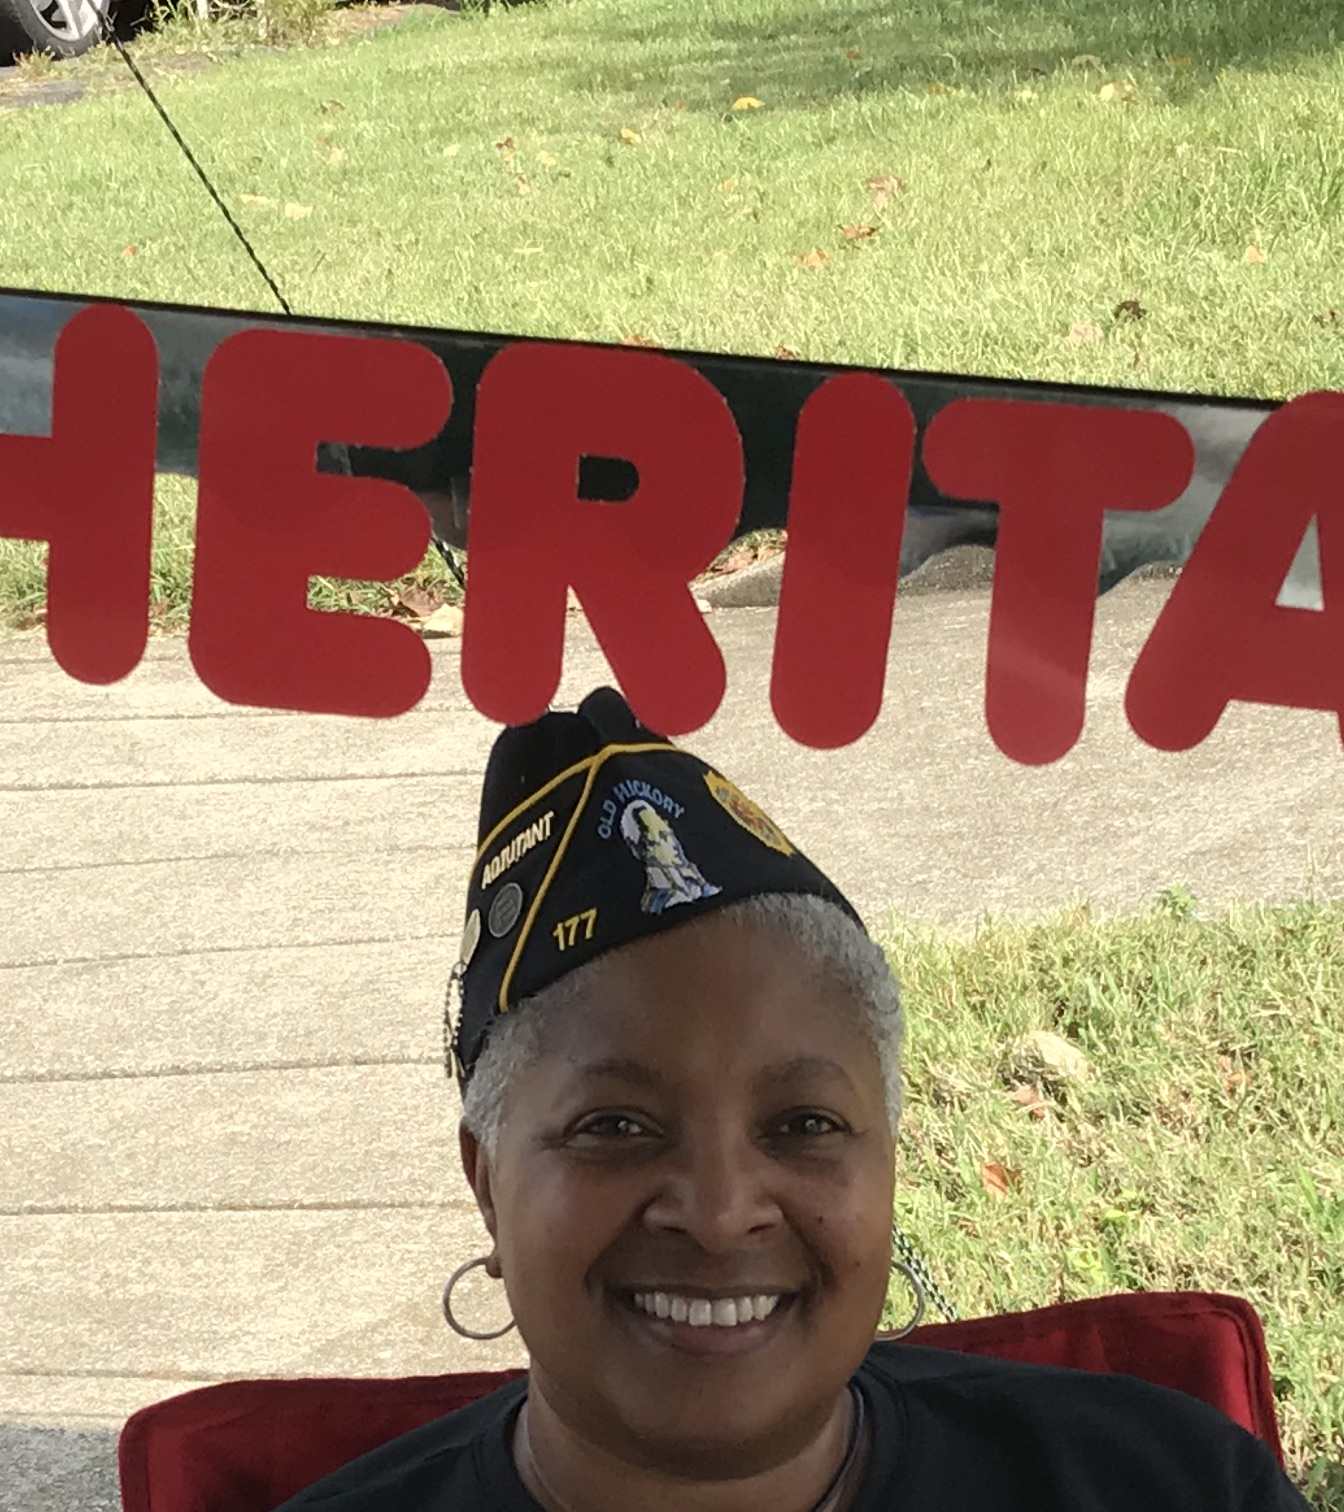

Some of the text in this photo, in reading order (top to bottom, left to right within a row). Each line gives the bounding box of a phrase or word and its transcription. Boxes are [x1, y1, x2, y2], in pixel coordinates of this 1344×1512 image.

[597, 779, 686, 839] OLD HICKORY
[480, 811, 554, 889] ADJUTANT
[553, 908, 597, 951] 177
